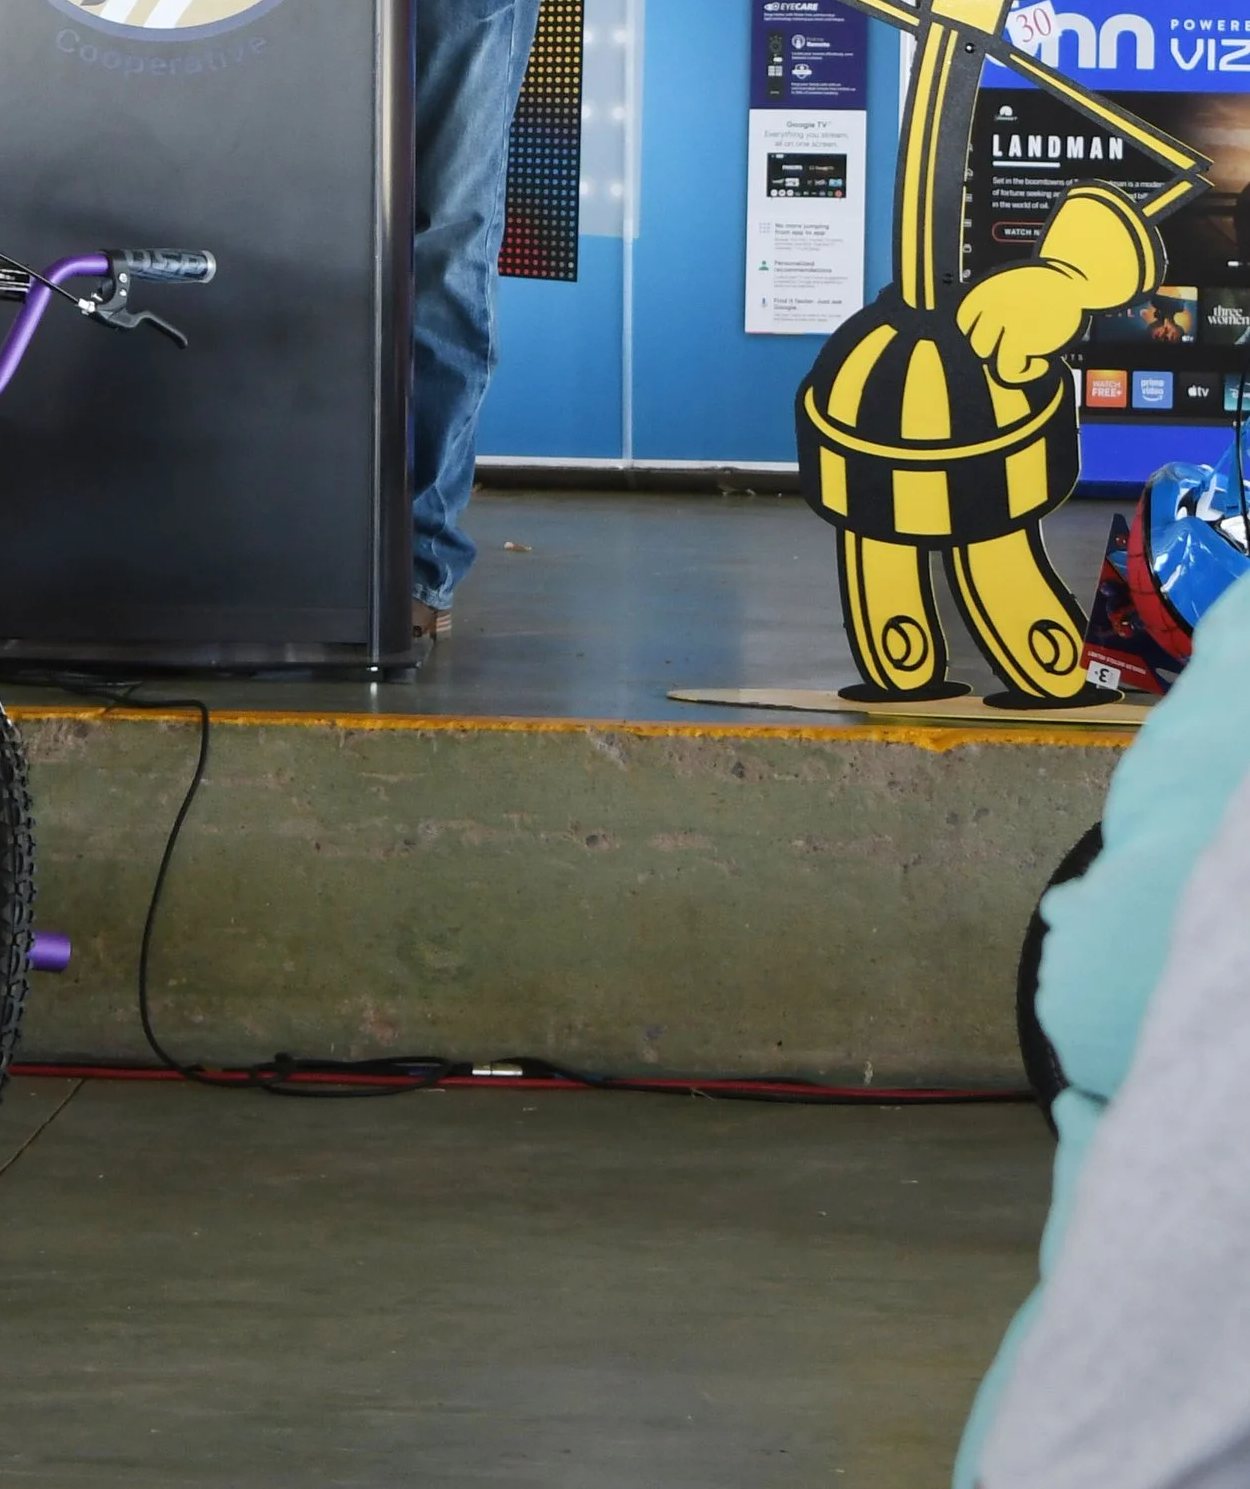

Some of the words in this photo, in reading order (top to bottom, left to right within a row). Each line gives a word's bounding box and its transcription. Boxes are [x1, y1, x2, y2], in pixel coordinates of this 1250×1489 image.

[780, 2, 819, 12] EYECARE
[1015, 7, 1052, 44] 30
[1170, 38, 1250, 72] VIZ
[787, 121, 815, 130] Google
[764, 131, 804, 140] Everything
[992, 134, 1124, 160] LANDMAN
[992, 177, 1005, 185] Set
[1005, 177, 1012, 185] in
[1013, 177, 1024, 185] the
[1025, 177, 1065, 186] boomtowns
[992, 189, 1000, 197] of
[1001, 189, 1025, 198] fortune
[1026, 190, 1053, 199] seeking
[1012, 201, 1031, 209] world
[1031, 201, 1039, 209] of
[1004, 228, 1032, 236] WATCH
[1213, 304, 1243, 318] three
[1207, 314, 1250, 326] women
[1092, 380, 1121, 389] WATCH
[1141, 378, 1165, 388] prime
[1091, 388, 1123, 398] FREE+
[1141, 386, 1165, 395] video
